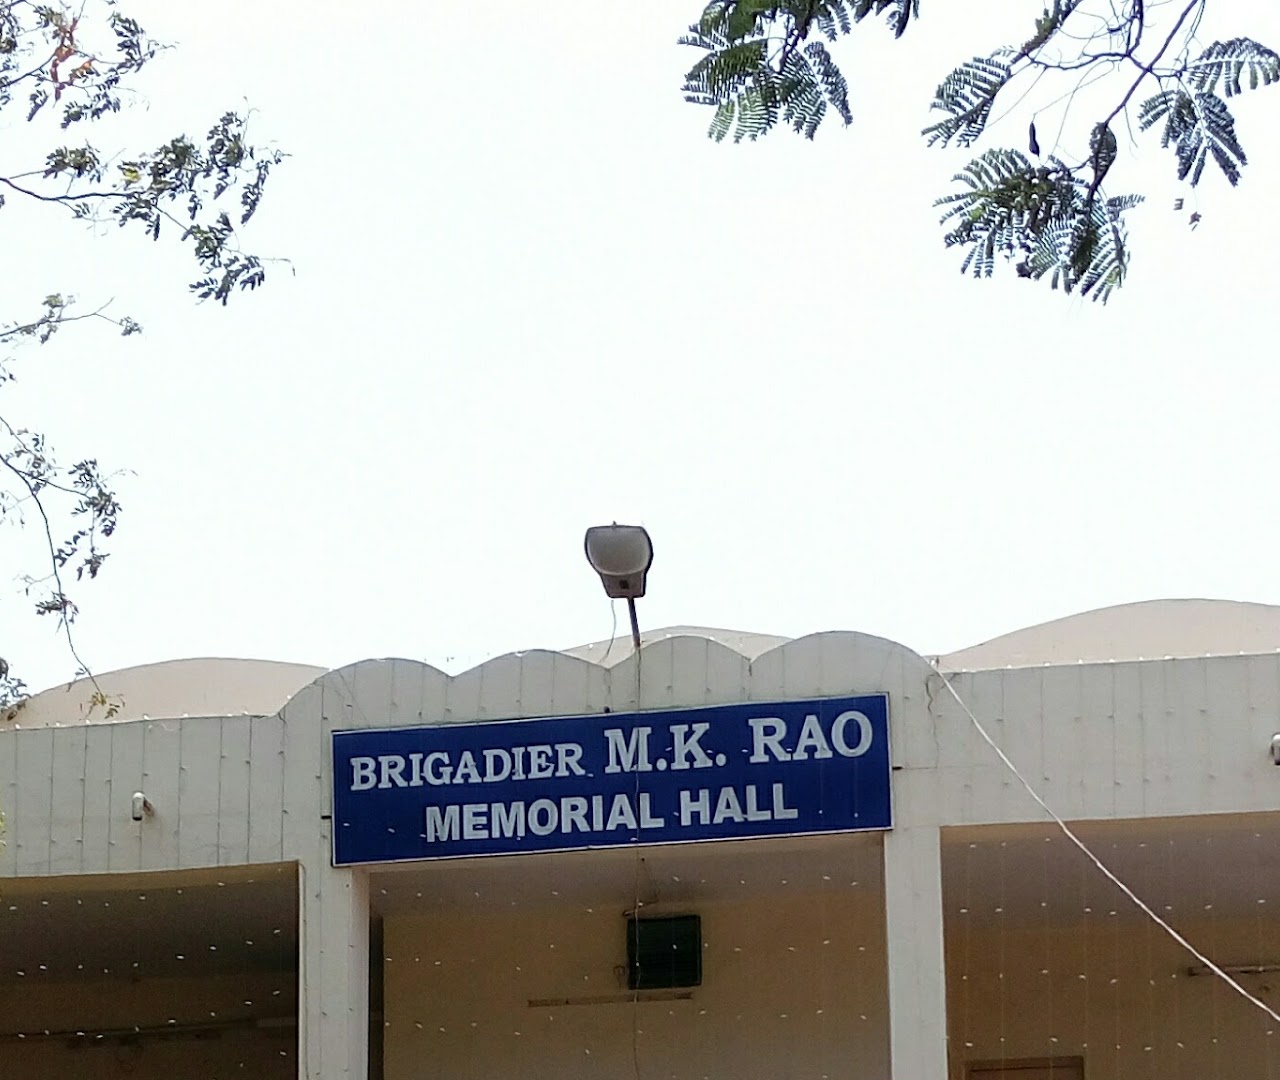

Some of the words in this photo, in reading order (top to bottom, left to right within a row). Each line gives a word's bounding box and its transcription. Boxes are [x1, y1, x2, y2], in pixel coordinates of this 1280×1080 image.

[349, 741, 587, 792] BRIGADIER
[604, 721, 727, 774] M.K.
[747, 709, 874, 764] RAO
[425, 791, 666, 843] MEMORIAL
[679, 783, 799, 827] HALL
